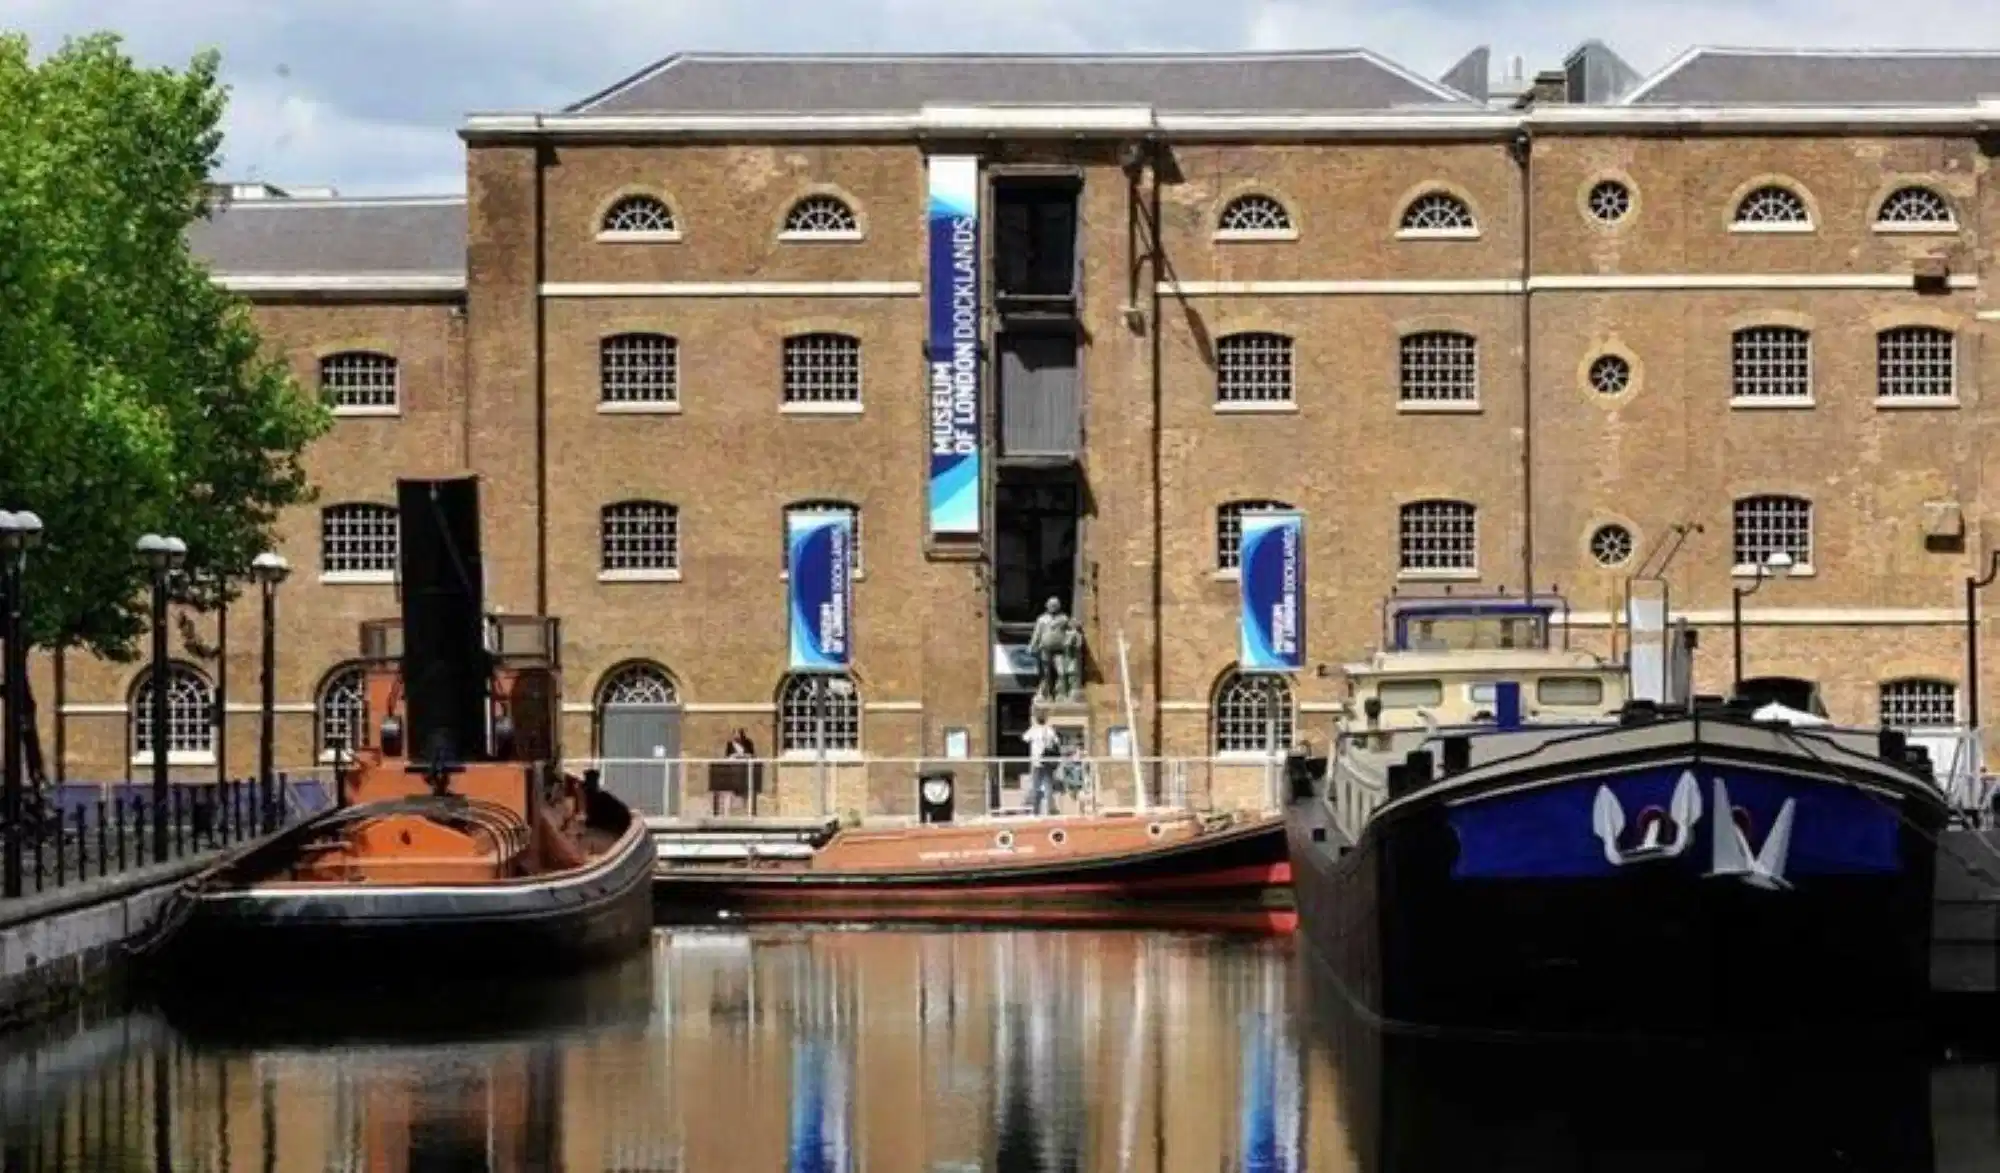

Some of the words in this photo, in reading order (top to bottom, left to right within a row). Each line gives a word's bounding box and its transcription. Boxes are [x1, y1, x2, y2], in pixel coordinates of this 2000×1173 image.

[953, 216, 976, 339] DOCKLANDS
[933, 361, 953, 456] MUSEUM
[954, 342, 976, 424] LONDON
[954, 429, 976, 454] OF
